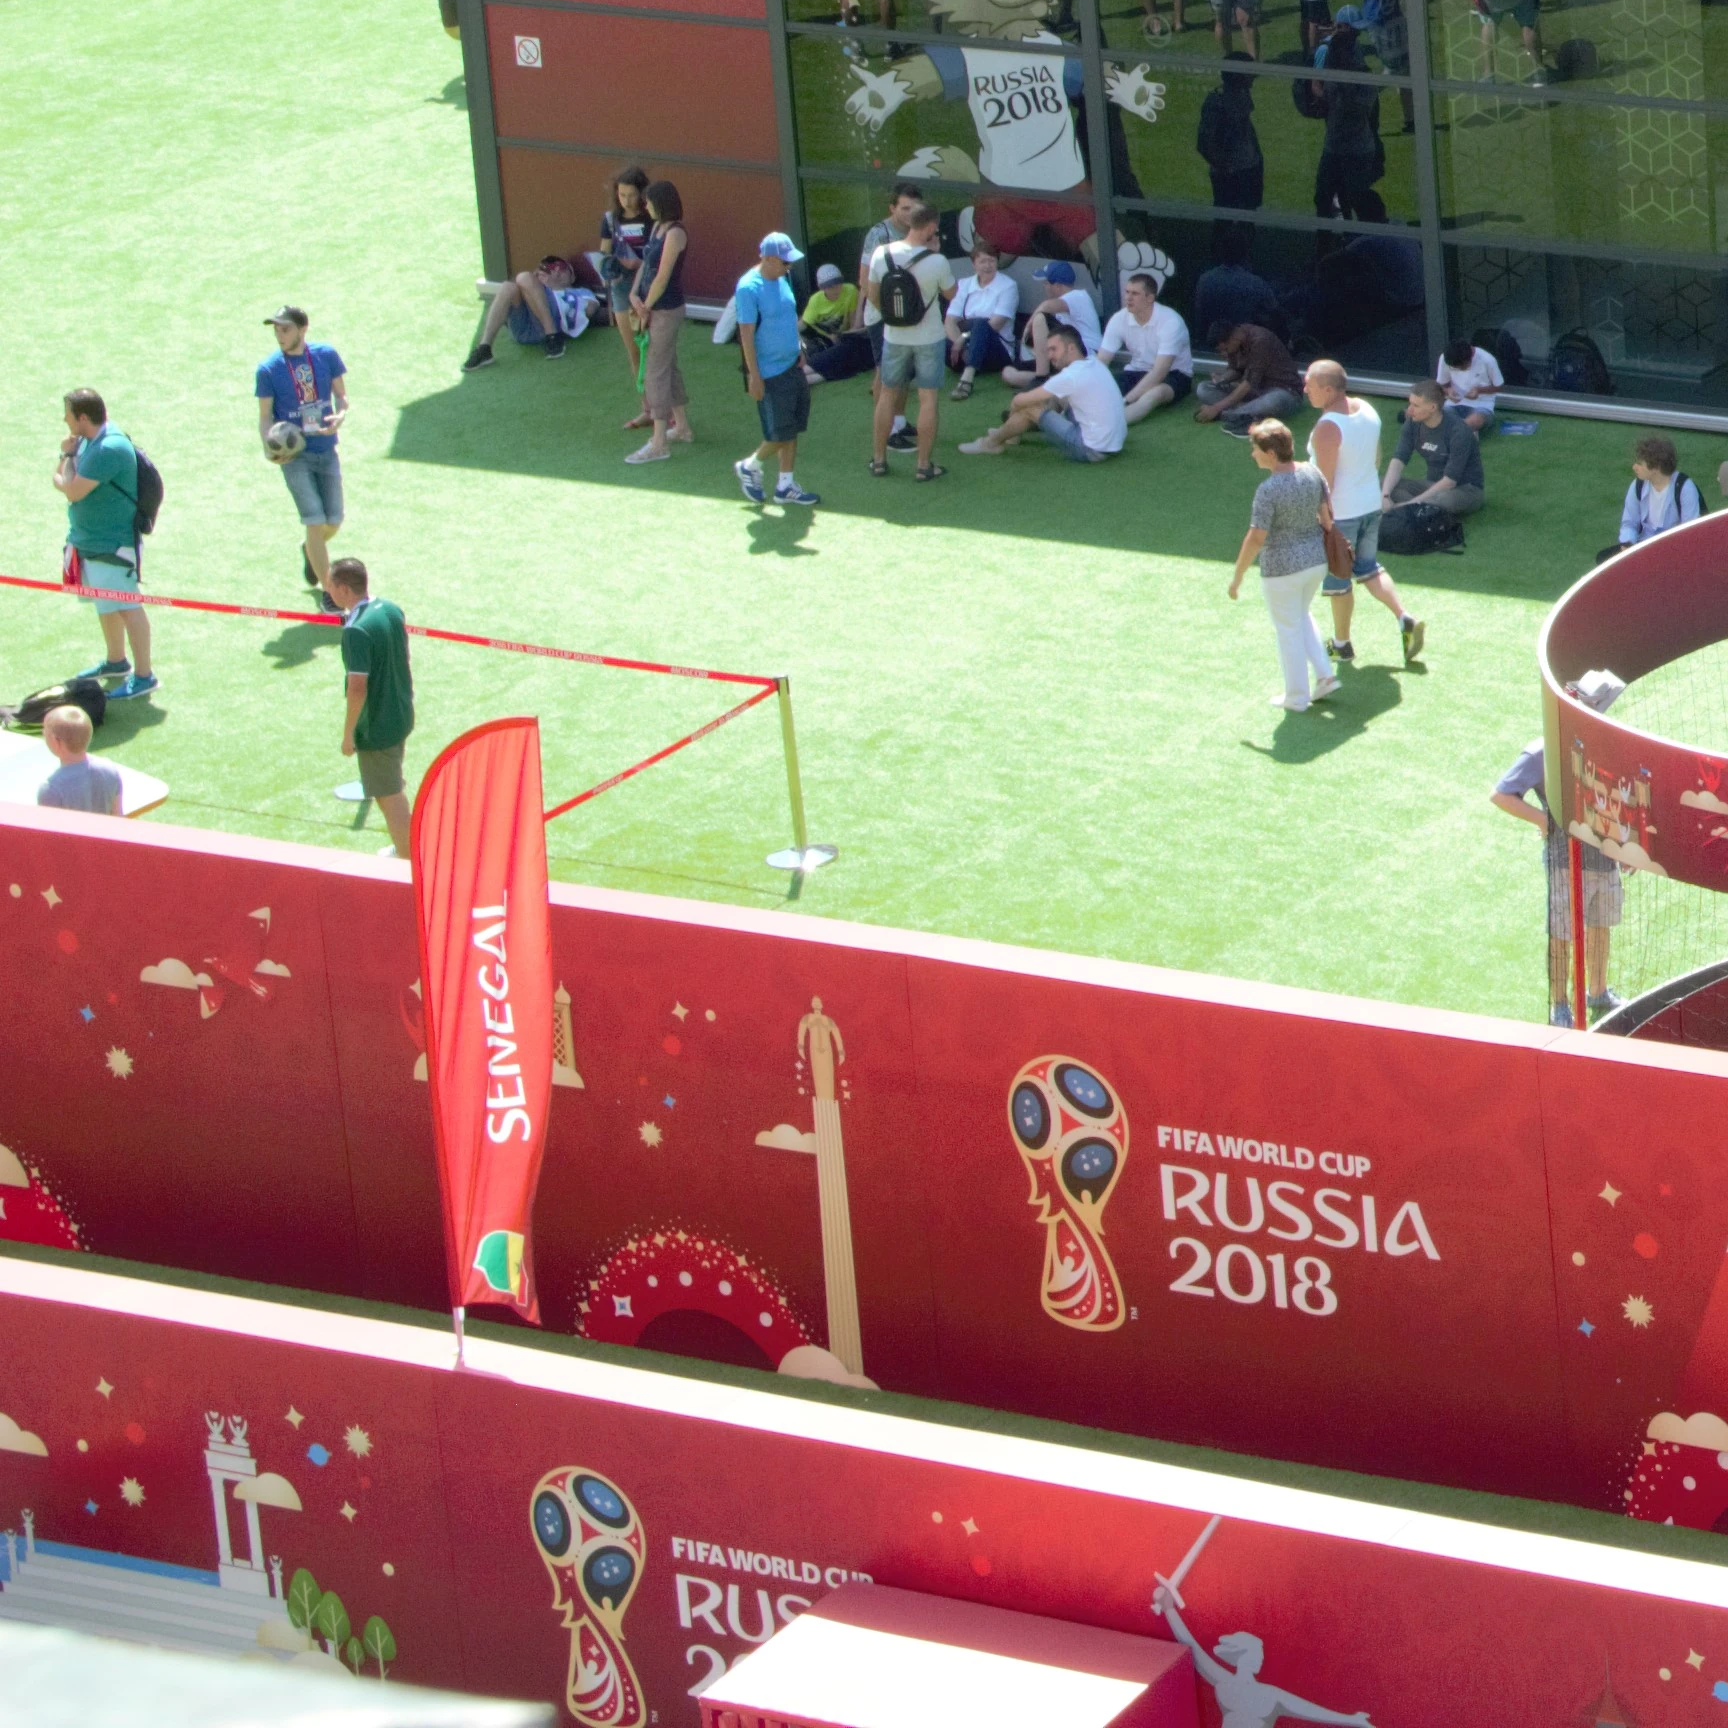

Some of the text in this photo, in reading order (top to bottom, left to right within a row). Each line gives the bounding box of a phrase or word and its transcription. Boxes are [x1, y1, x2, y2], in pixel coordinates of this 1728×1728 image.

[973, 64, 1056, 96] RUSSIA
[983, 85, 1063, 129] 2018
[472, 889, 532, 1144] SENEGAL
[1157, 1125, 1371, 1178] FIFA WORLD CUP
[1160, 1163, 1442, 1261] RUSSIA
[1169, 1236, 1339, 1316] 2018
[672, 1536, 728, 1569] FIFA
[727, 1547, 821, 1585] WORLD
[676, 1573, 812, 1643] RUS
